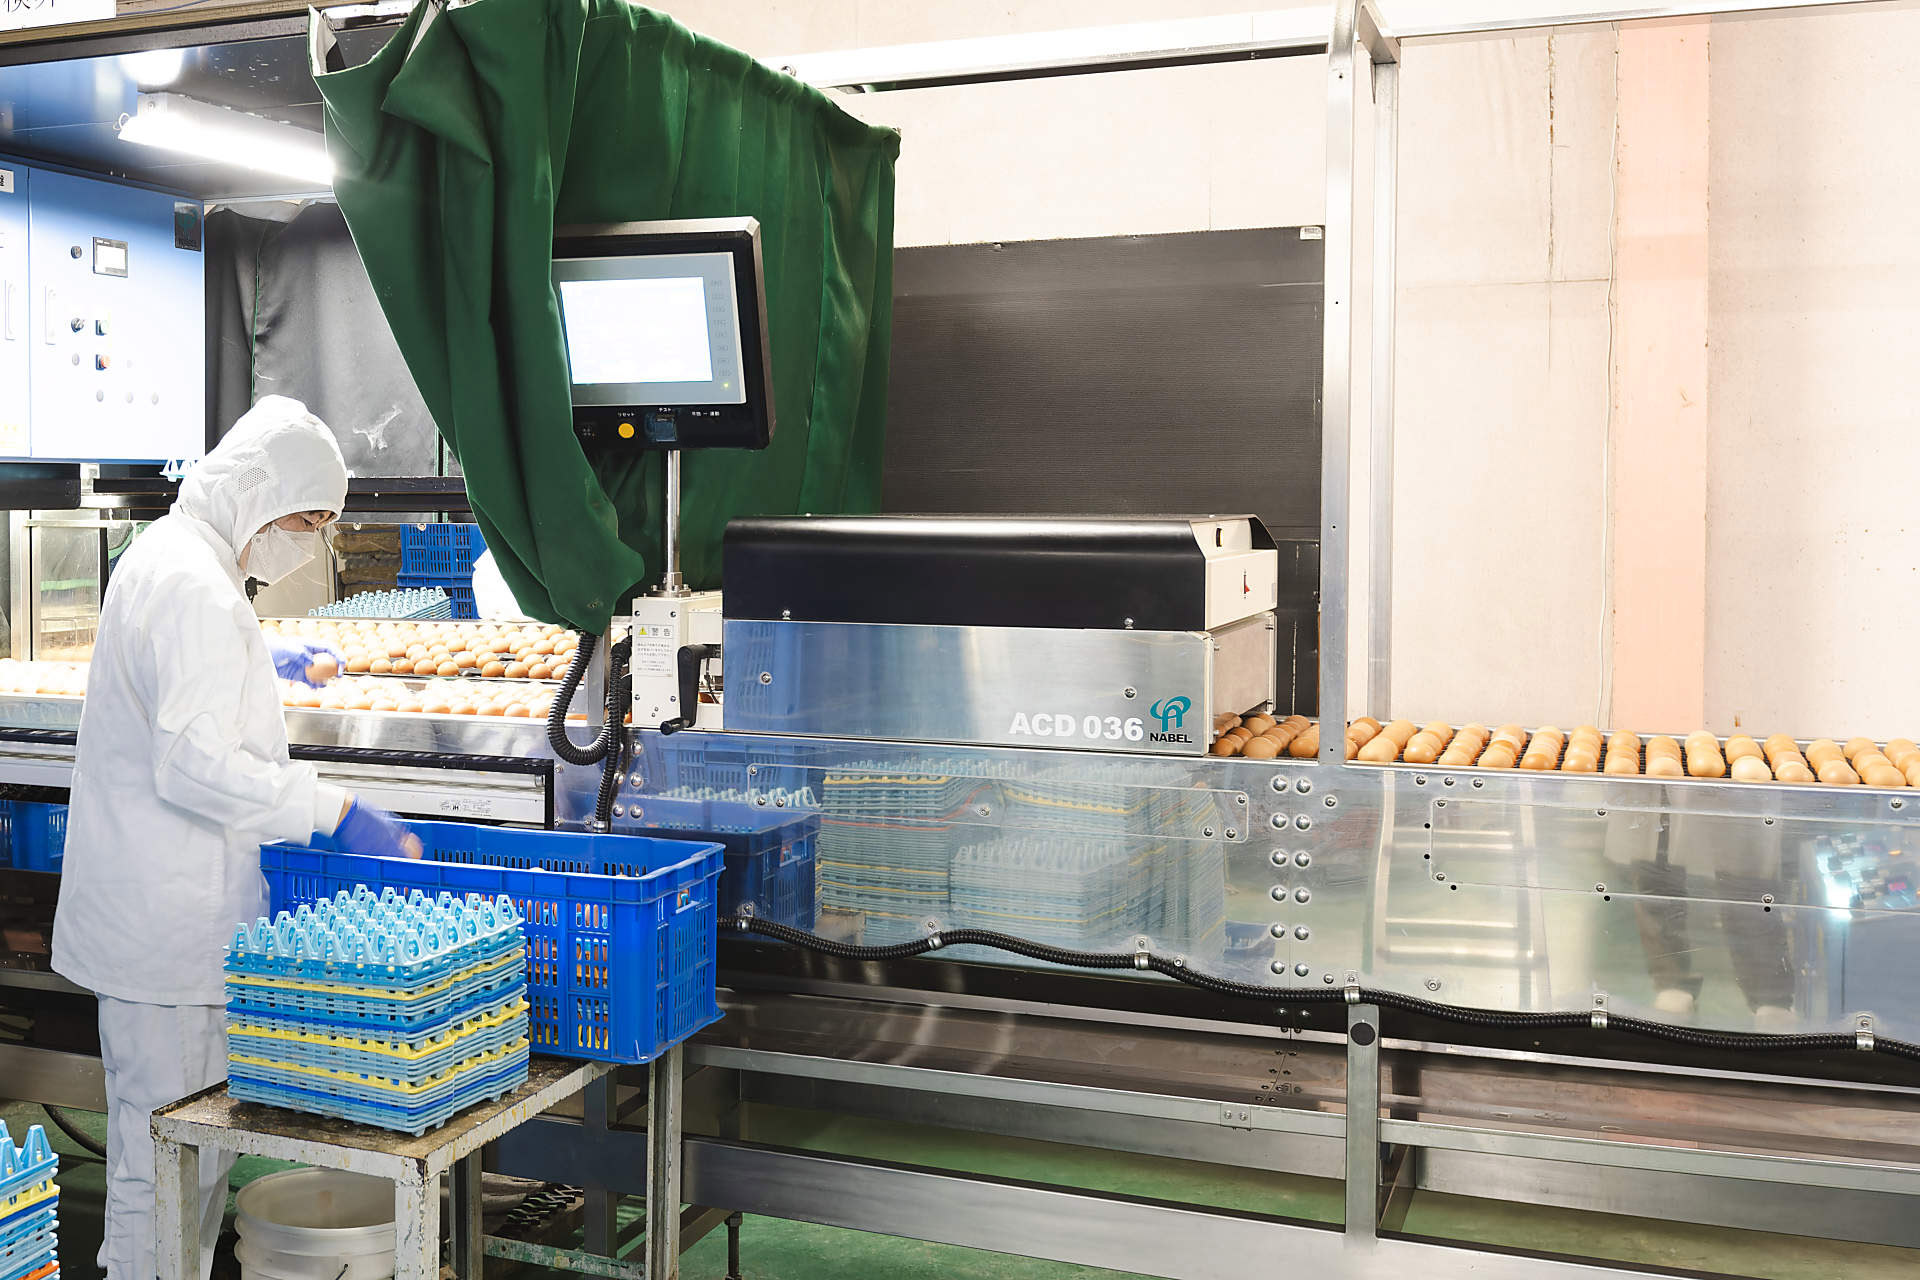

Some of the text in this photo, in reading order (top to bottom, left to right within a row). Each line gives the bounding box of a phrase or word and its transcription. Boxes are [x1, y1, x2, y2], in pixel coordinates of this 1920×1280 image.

[1008, 712, 1144, 741] ACD 036
[1150, 733, 1192, 744] NABEL
